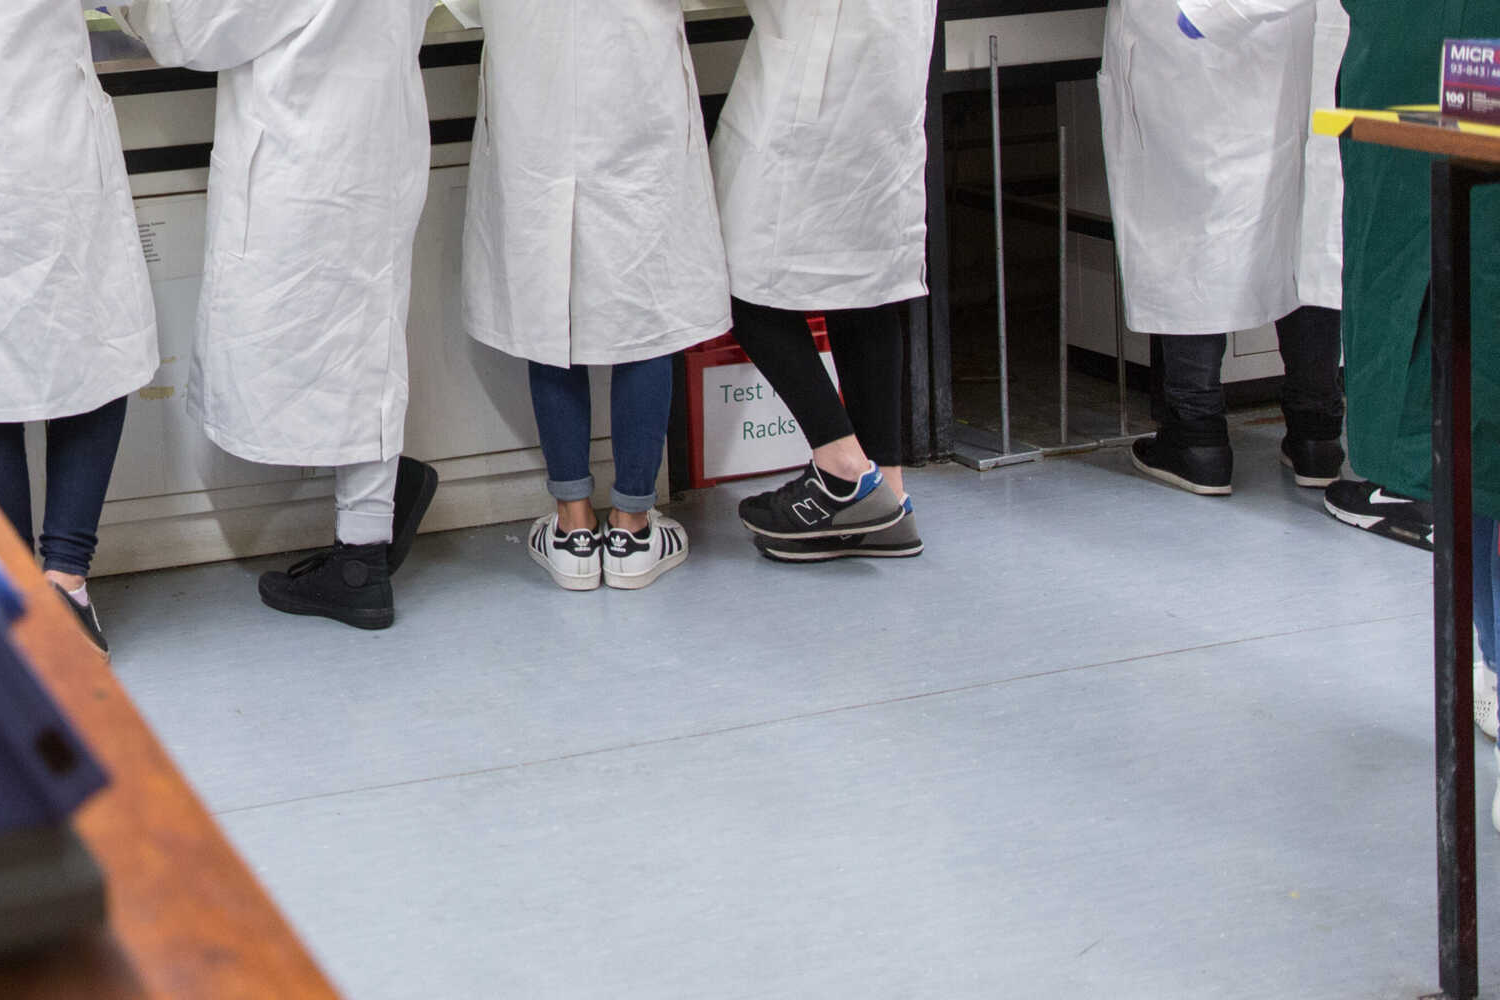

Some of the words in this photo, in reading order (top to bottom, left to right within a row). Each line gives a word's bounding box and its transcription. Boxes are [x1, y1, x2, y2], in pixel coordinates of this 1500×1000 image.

[1445, 90, 1465, 104] 100
[720, 383, 763, 403] Test
[743, 416, 796, 440] Racks
